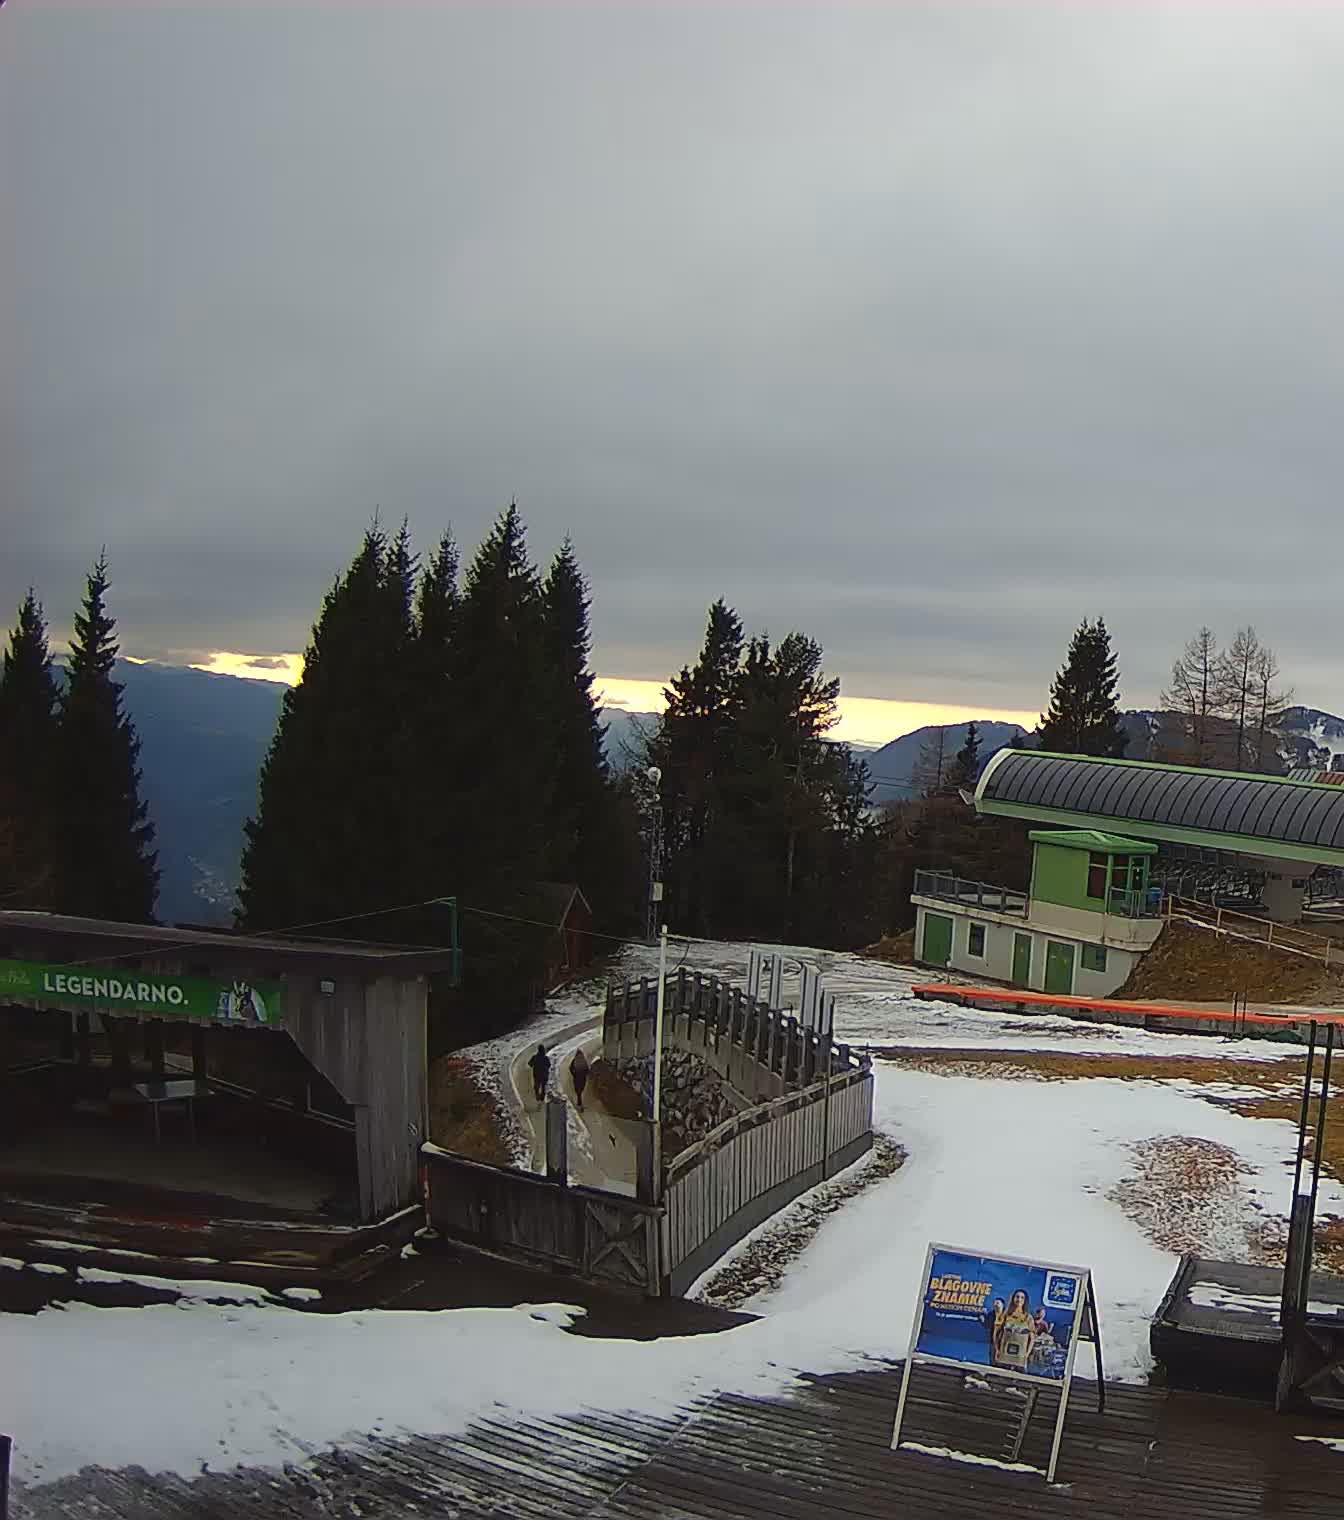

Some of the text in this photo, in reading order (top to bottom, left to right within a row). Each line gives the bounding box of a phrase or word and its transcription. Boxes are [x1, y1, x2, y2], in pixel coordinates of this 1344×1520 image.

[43, 972, 190, 1006] LEGENDARNO.
[930, 1277, 992, 1296] BLAGOVNE
[932, 1290, 985, 1307] ZNAMKE
